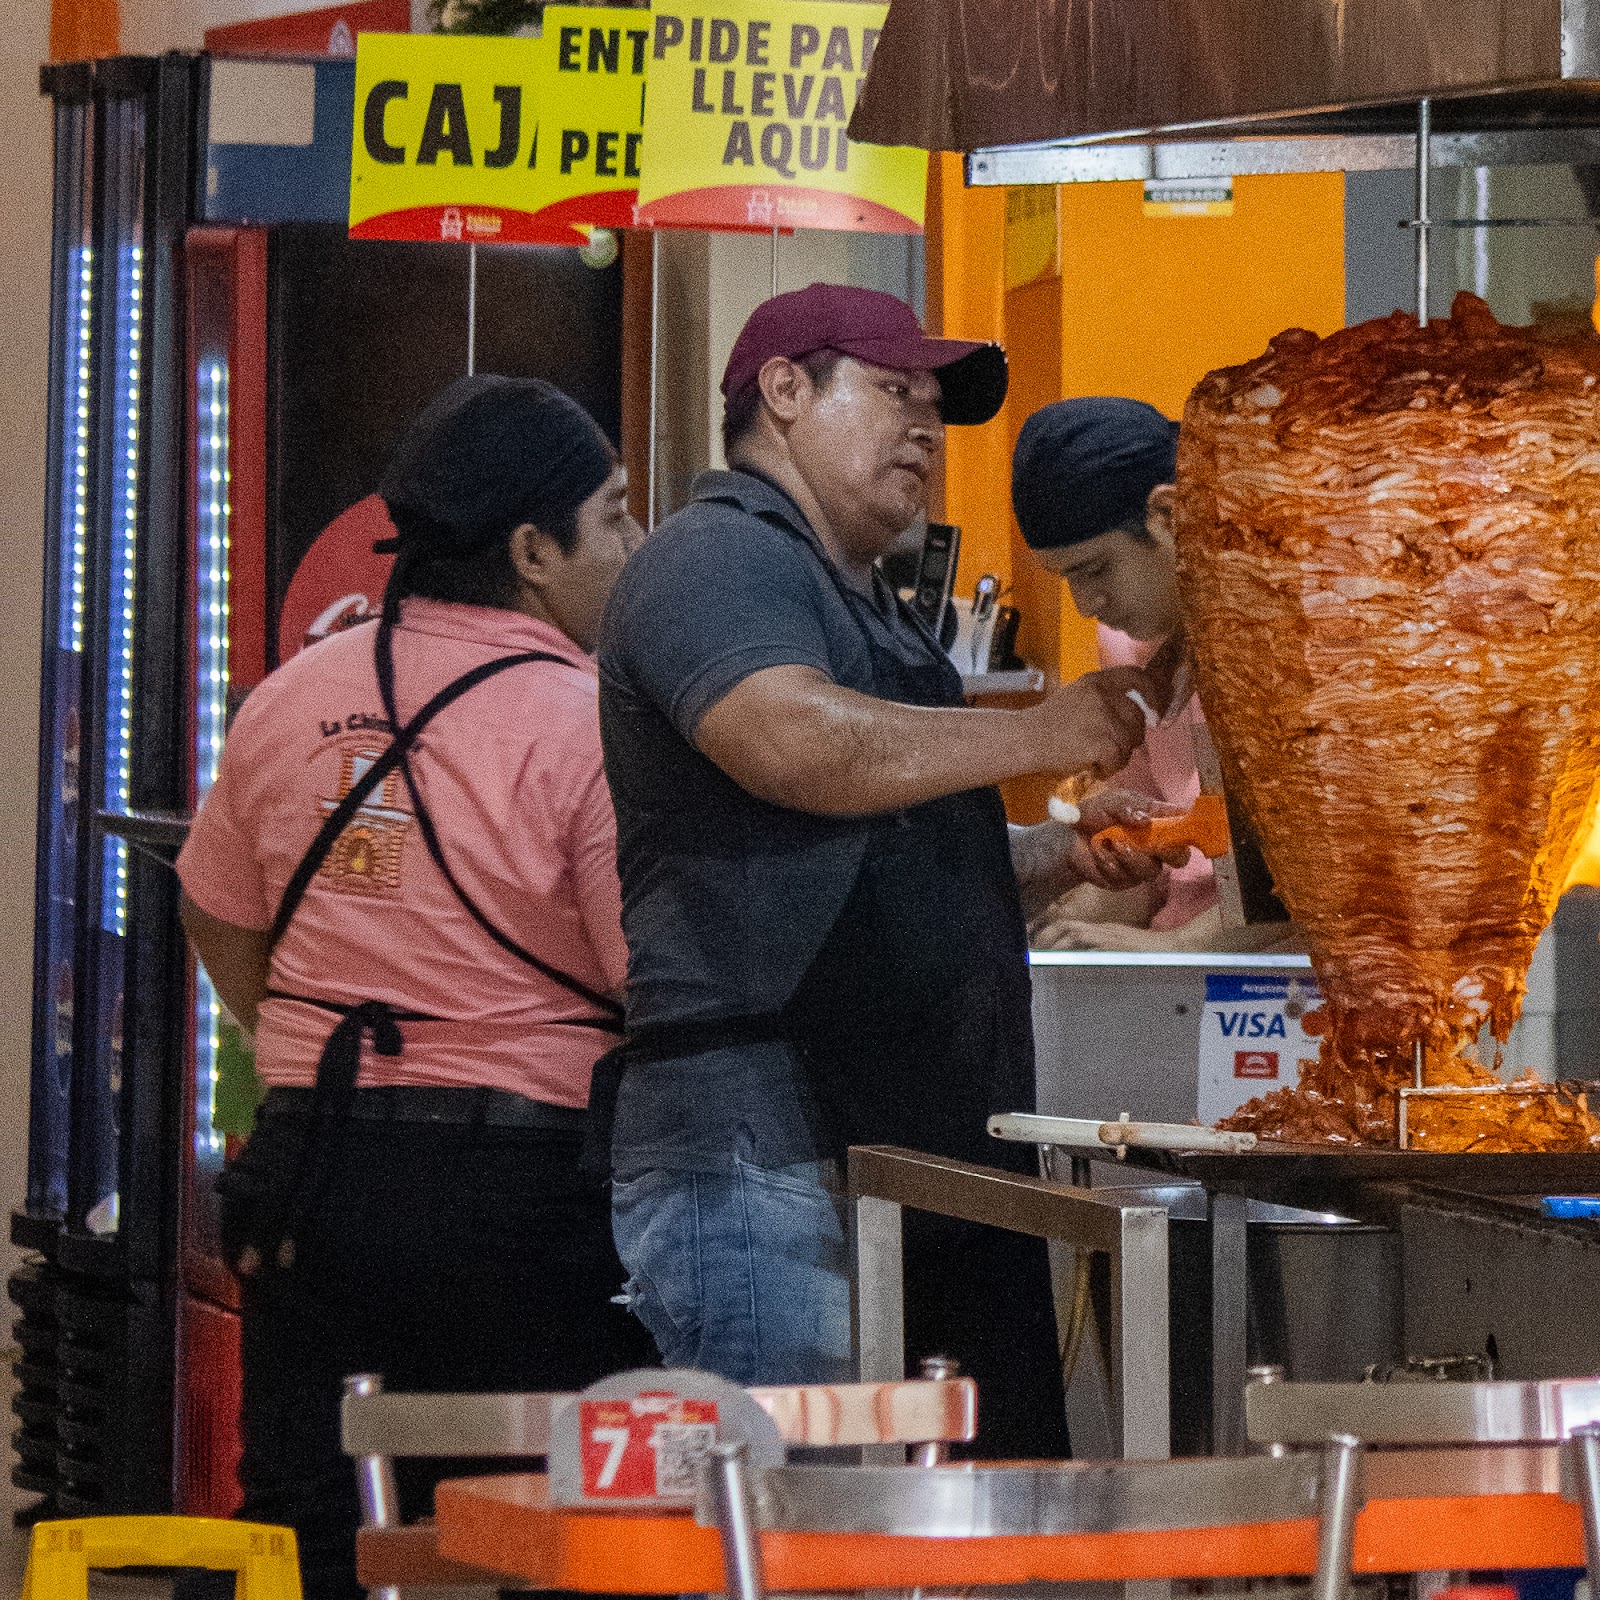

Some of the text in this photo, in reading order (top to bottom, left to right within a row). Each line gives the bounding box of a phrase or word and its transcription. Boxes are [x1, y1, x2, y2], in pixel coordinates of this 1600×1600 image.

[558, 26, 649, 74] ENT
[653, 14, 771, 66] PIDE
[691, 68, 866, 121] LLEVA
[363, 80, 540, 169] CAJ
[722, 121, 849, 178] AQUI
[560, 130, 642, 177] PED
[1214, 1011, 1287, 1038] VISA
[592, 1427, 629, 1489] 7
